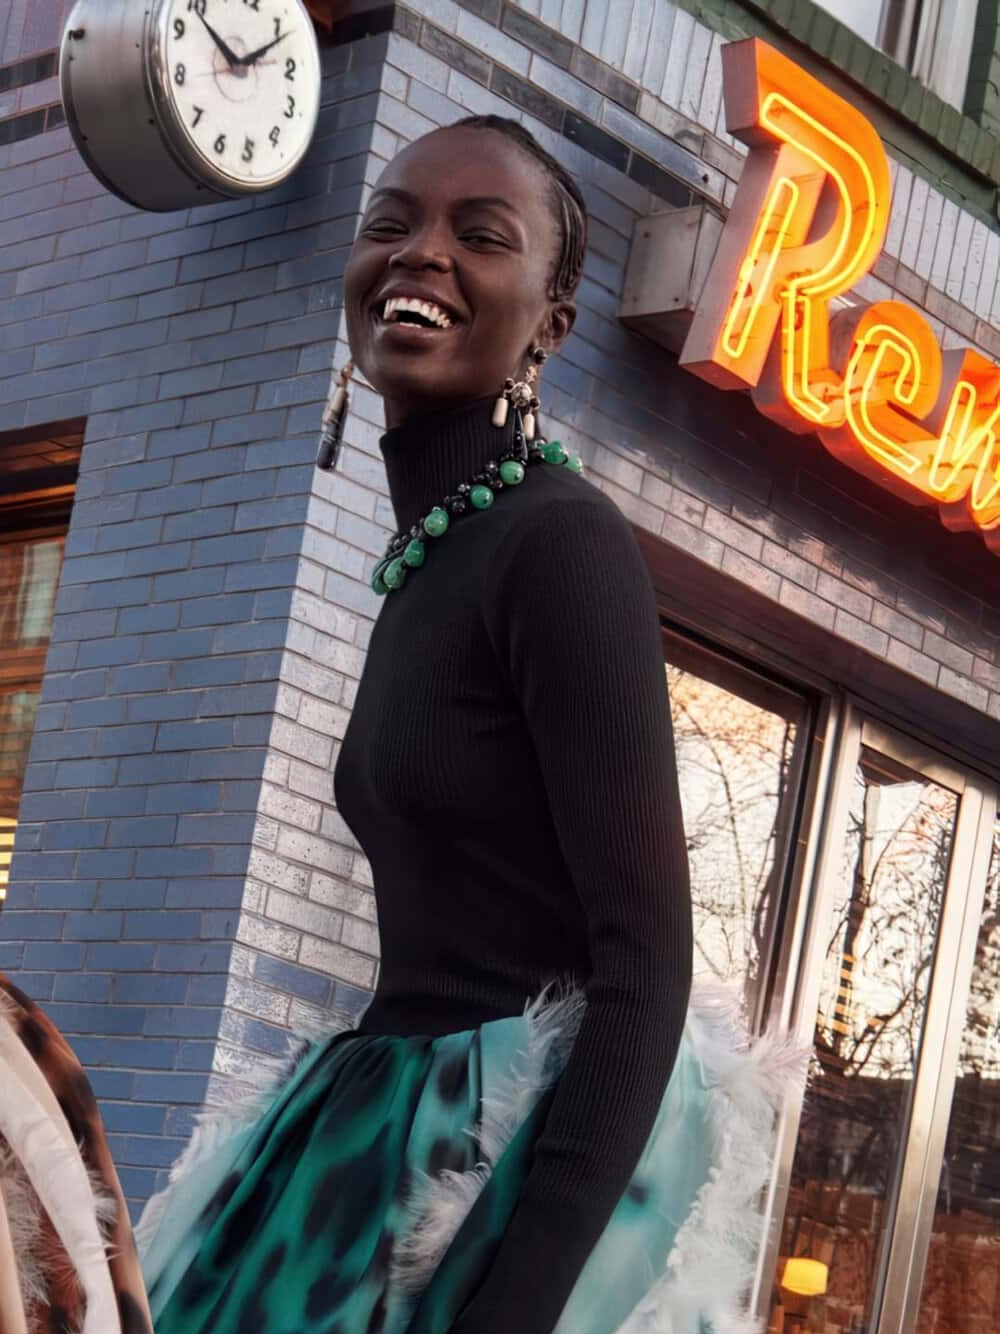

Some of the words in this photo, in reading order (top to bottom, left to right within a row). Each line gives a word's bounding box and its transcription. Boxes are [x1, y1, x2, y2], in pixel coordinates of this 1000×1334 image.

[173, 18, 185, 40] 9
[272, 17, 281, 40] 1
[174, 63, 186, 86] 8
[284, 58, 296, 82] 2
[192, 105, 204, 128] 7
[284, 96, 296, 119] 3
[214, 133, 226, 154] 6
[268, 126, 281, 148] 4
[241, 137, 255, 163] 5
